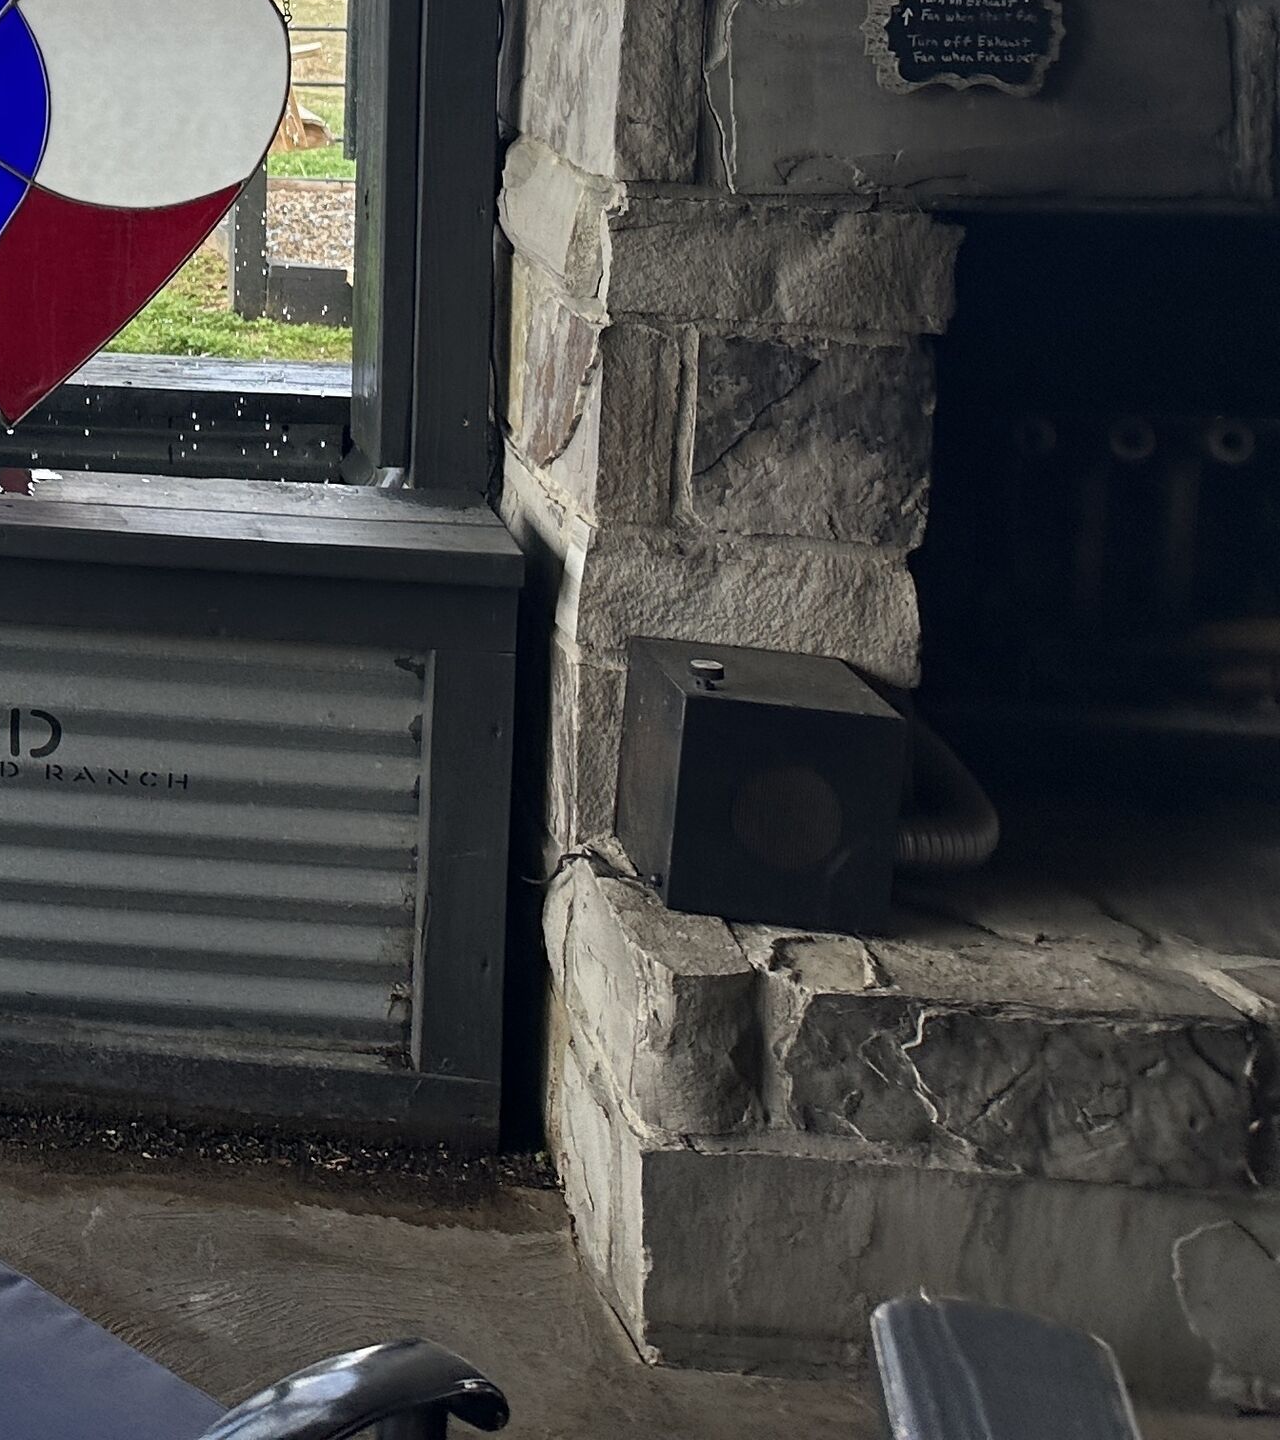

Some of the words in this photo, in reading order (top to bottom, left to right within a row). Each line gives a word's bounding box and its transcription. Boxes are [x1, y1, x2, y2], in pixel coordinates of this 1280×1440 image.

[921, 8, 940, 22] Fan
[945, 10, 973, 22] when
[907, 34, 938, 47] Turn
[943, 34, 972, 48] off
[977, 35, 1031, 47] Exhaust
[913, 51, 936, 63] Fan
[941, 51, 973, 63] when
[1004, 52, 1014, 63] is
[0, 761, 19, 778] D
[45, 763, 188, 790] RANCH
